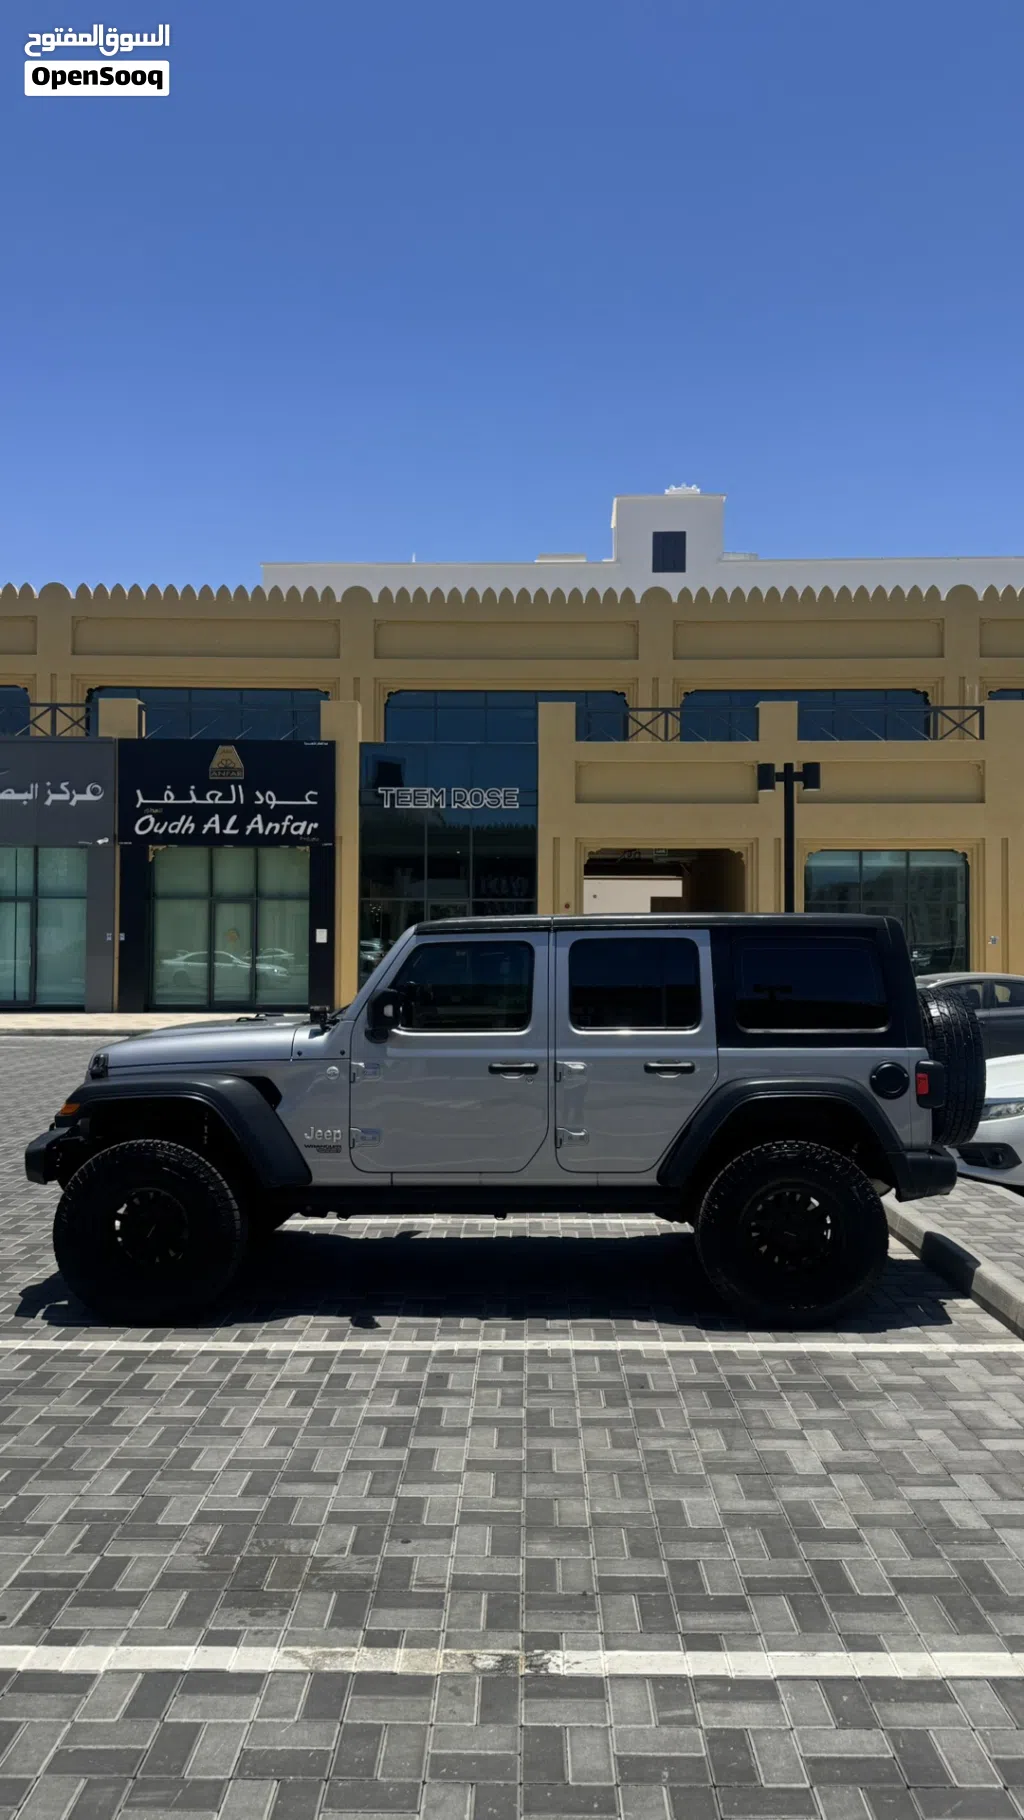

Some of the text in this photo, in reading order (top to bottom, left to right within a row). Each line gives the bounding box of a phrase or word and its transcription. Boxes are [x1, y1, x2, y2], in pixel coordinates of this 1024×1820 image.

[44, 781, 104, 807] مركز
[136, 784, 318, 810] عود العنفر
[378, 787, 520, 809] TEEM ROSE
[134, 813, 319, 836] Oudh AL Anfar
[303, 1126, 342, 1143] Jeep
